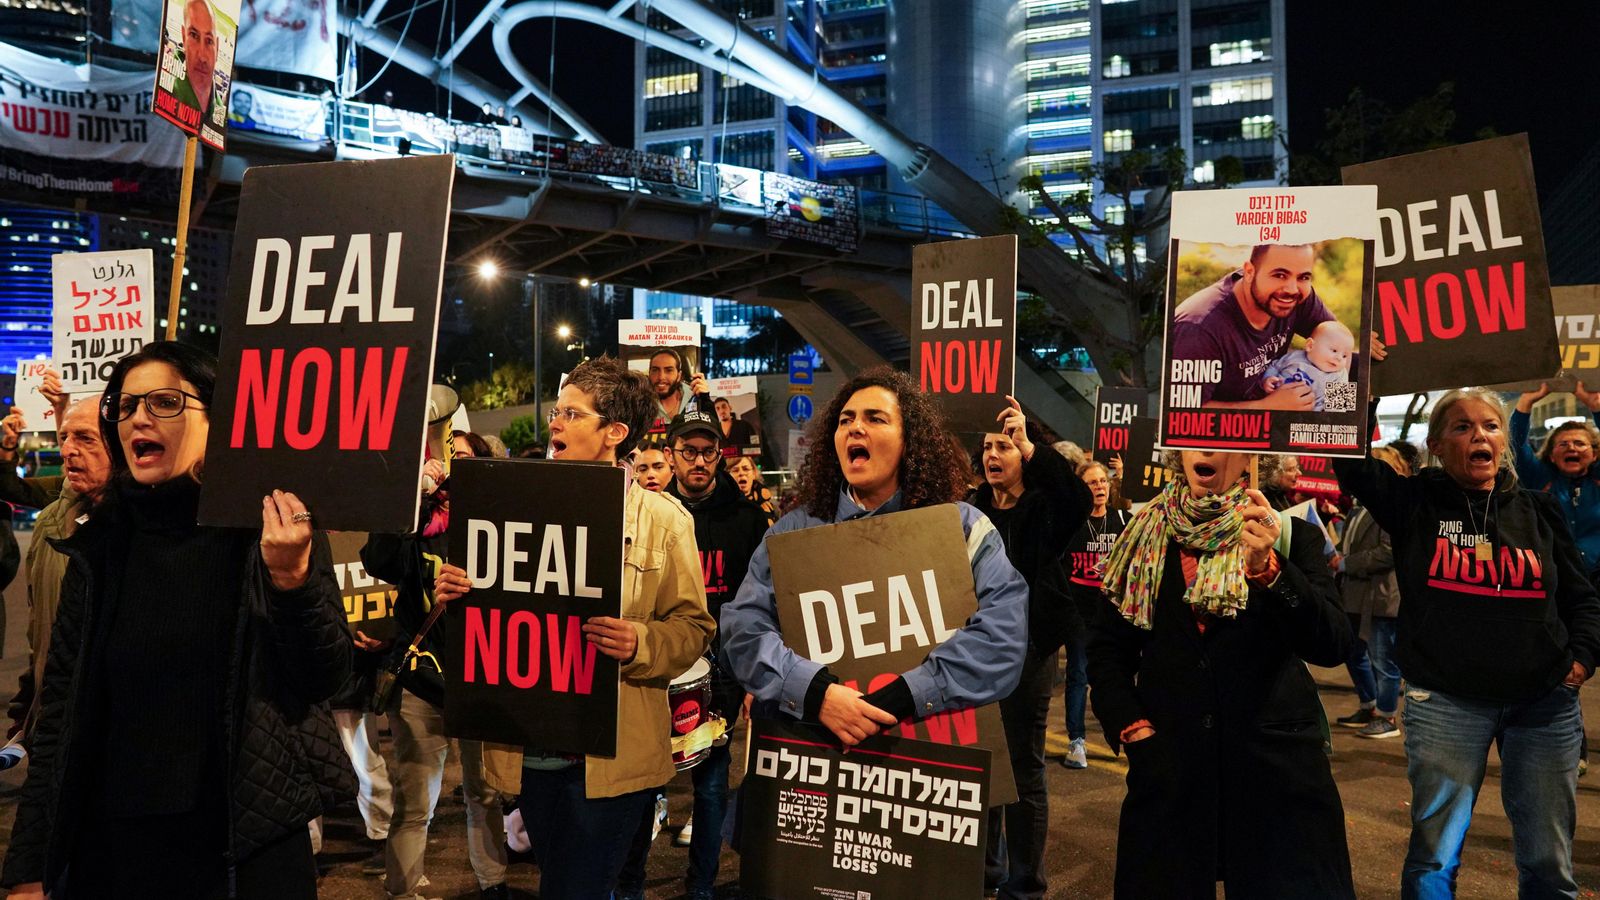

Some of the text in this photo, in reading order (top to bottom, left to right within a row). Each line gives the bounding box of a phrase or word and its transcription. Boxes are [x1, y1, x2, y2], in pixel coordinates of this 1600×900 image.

[156, 89, 201, 129] HOME NOW!
[78, 114, 147, 143] הביתה
[1249, 195, 1295, 210] ירדן ביבס
[1235, 210, 1307, 225] YARDEN BIBAS
[1375, 189, 1523, 267] DEAL
[1260, 226, 1280, 242] (34)
[93, 260, 135, 282] גלנט
[245, 231, 414, 326] DEAL
[71, 281, 141, 310] תציל
[921, 278, 1003, 330] DEAL
[1378, 261, 1526, 346] NOW
[72, 338, 142, 359] תעשה
[62, 361, 118, 385] סקה
[920, 339, 1002, 394] NOW
[1171, 359, 1222, 384] BRING
[230, 347, 409, 450] NOW
[1169, 384, 1202, 408] HIM
[1168, 411, 1271, 439] HOME NOW!
[1290, 422, 1357, 433] HOSTAGES AND MISSING
[1290, 431, 1357, 446] FAMILIES FORUM
[466, 519, 603, 598] DEAL
[1429, 537, 1543, 589] NOW!
[799, 569, 960, 665] DEAL
[464, 607, 598, 694] NOW
[756, 748, 982, 811] במלחמה כולם
[778, 802, 827, 819] לכיבוש
[780, 788, 828, 807] מסתכלים
[777, 813, 826, 835] בעיניים
[836, 794, 979, 846] מפסידים
[834, 827, 892, 850] IN WAR
[832, 855, 878, 875] LOSES
[833, 841, 913, 868] EVERYONE
